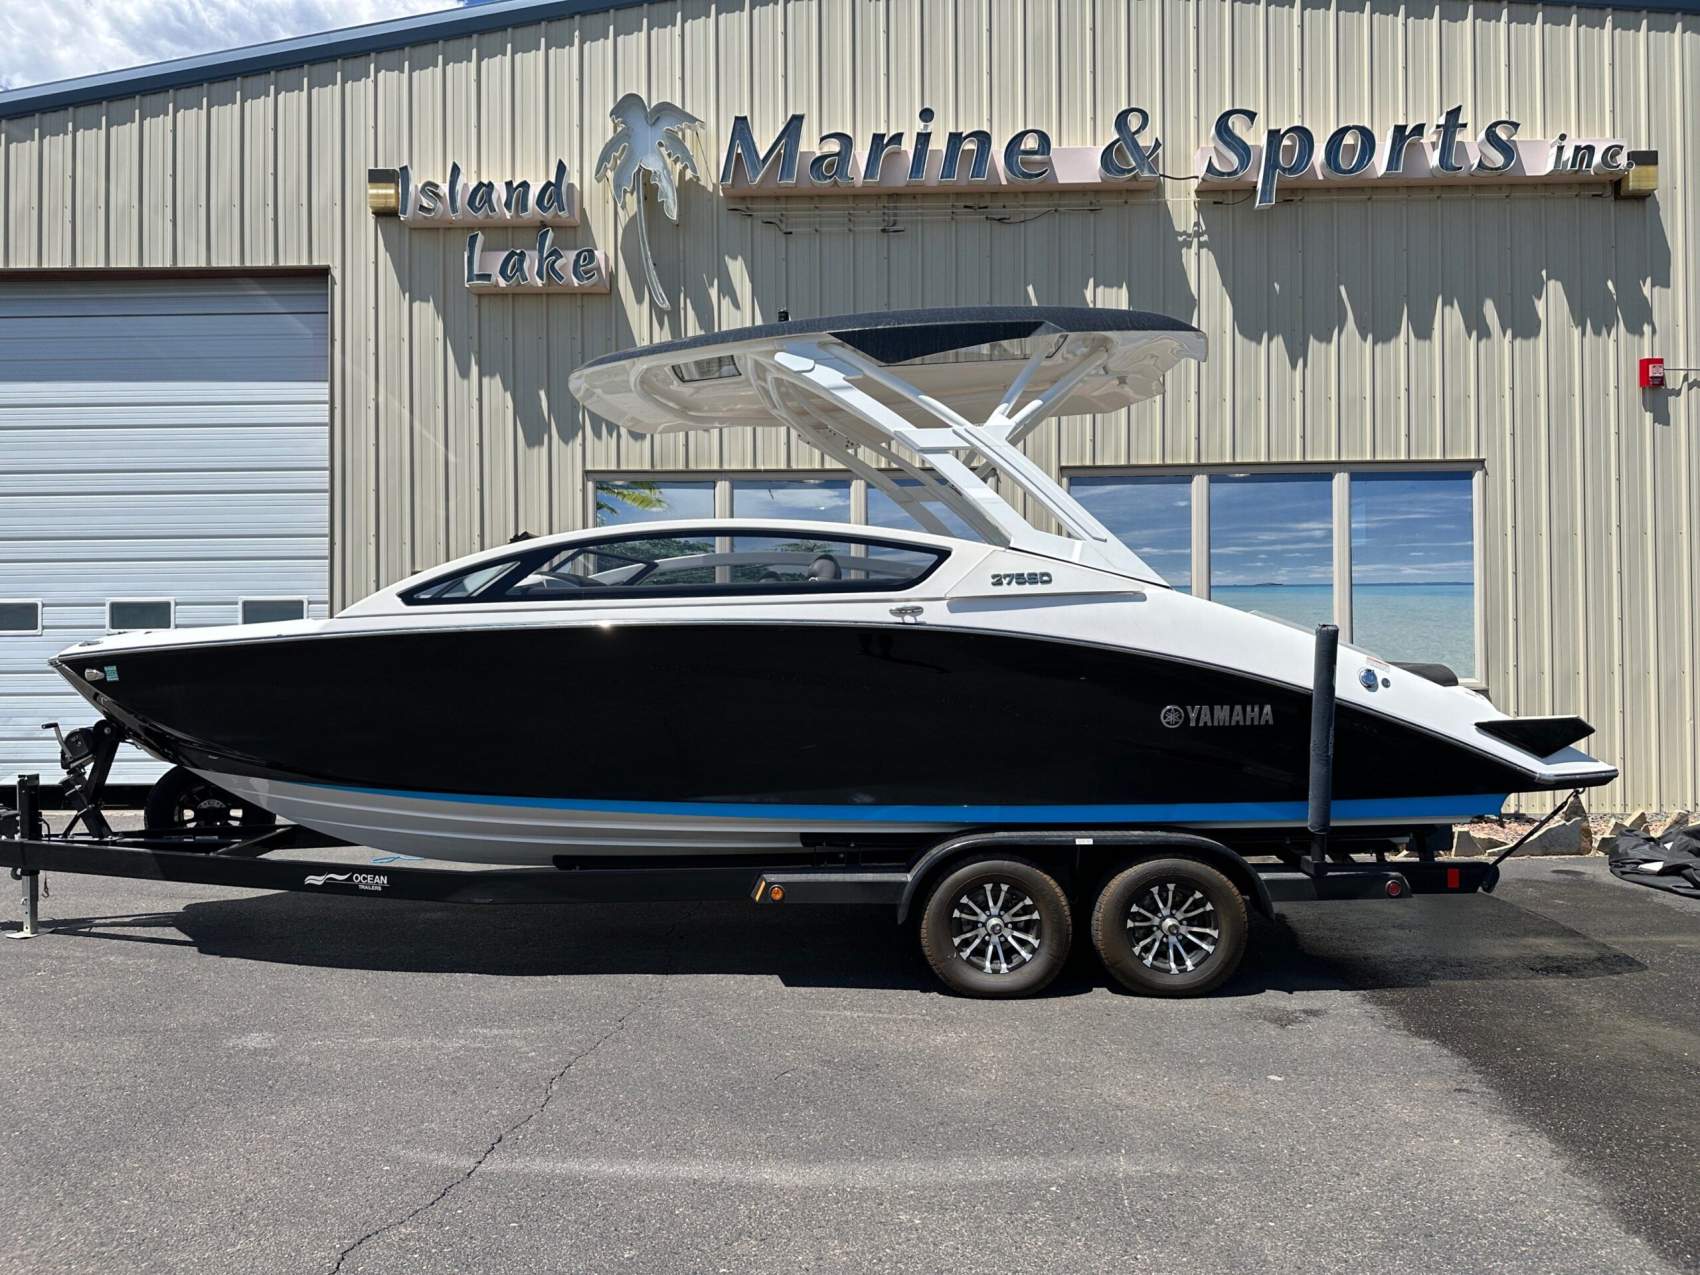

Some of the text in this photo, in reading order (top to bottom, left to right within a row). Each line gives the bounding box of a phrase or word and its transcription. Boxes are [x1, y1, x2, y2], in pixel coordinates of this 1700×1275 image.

[720, 104, 1636, 210] Marine & Sports inc.
[398, 157, 570, 221] Island
[465, 228, 600, 286] Lake
[990, 572, 1053, 586] 275SD
[1186, 704, 1274, 727] YAMAHA
[352, 873, 388, 885] OCEAN
